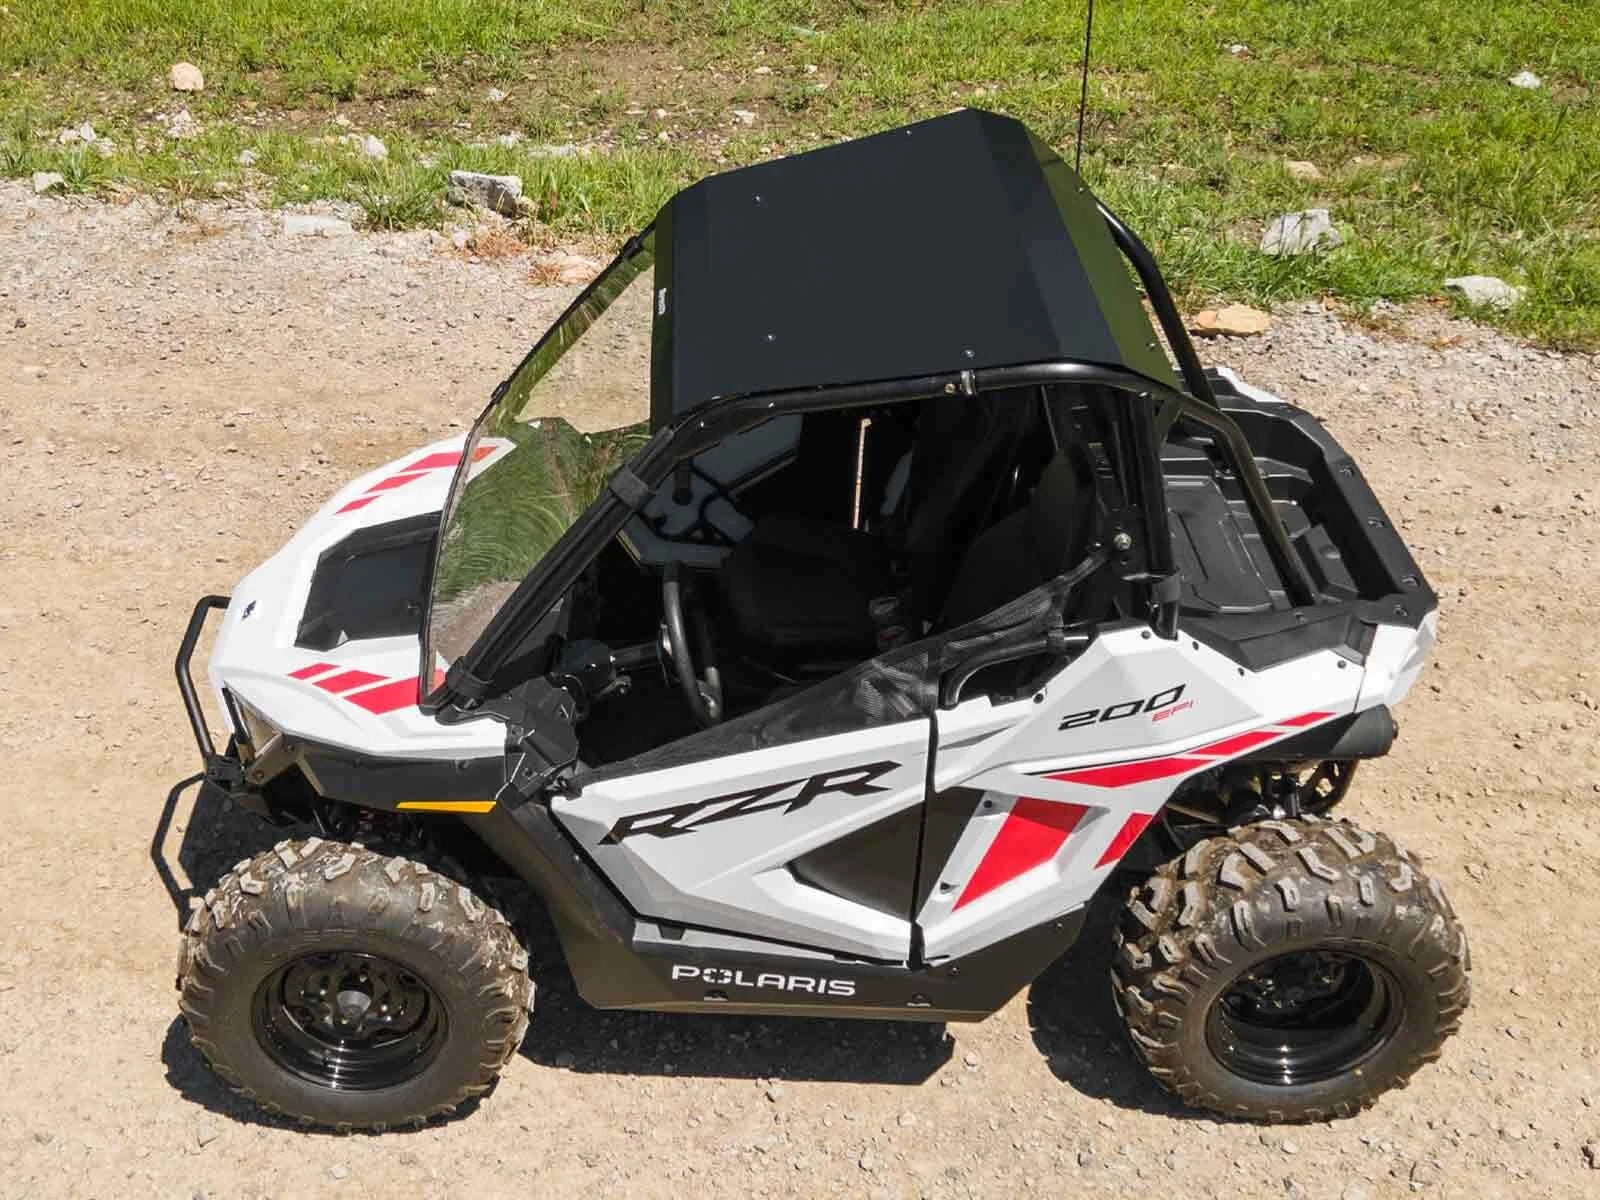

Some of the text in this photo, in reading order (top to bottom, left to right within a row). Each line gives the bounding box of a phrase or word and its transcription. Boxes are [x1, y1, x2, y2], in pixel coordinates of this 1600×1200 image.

[1058, 683, 1186, 731] 200
[1152, 700, 1194, 721] EFI
[598, 760, 902, 845] RZR
[671, 964, 856, 996] POLARIS
